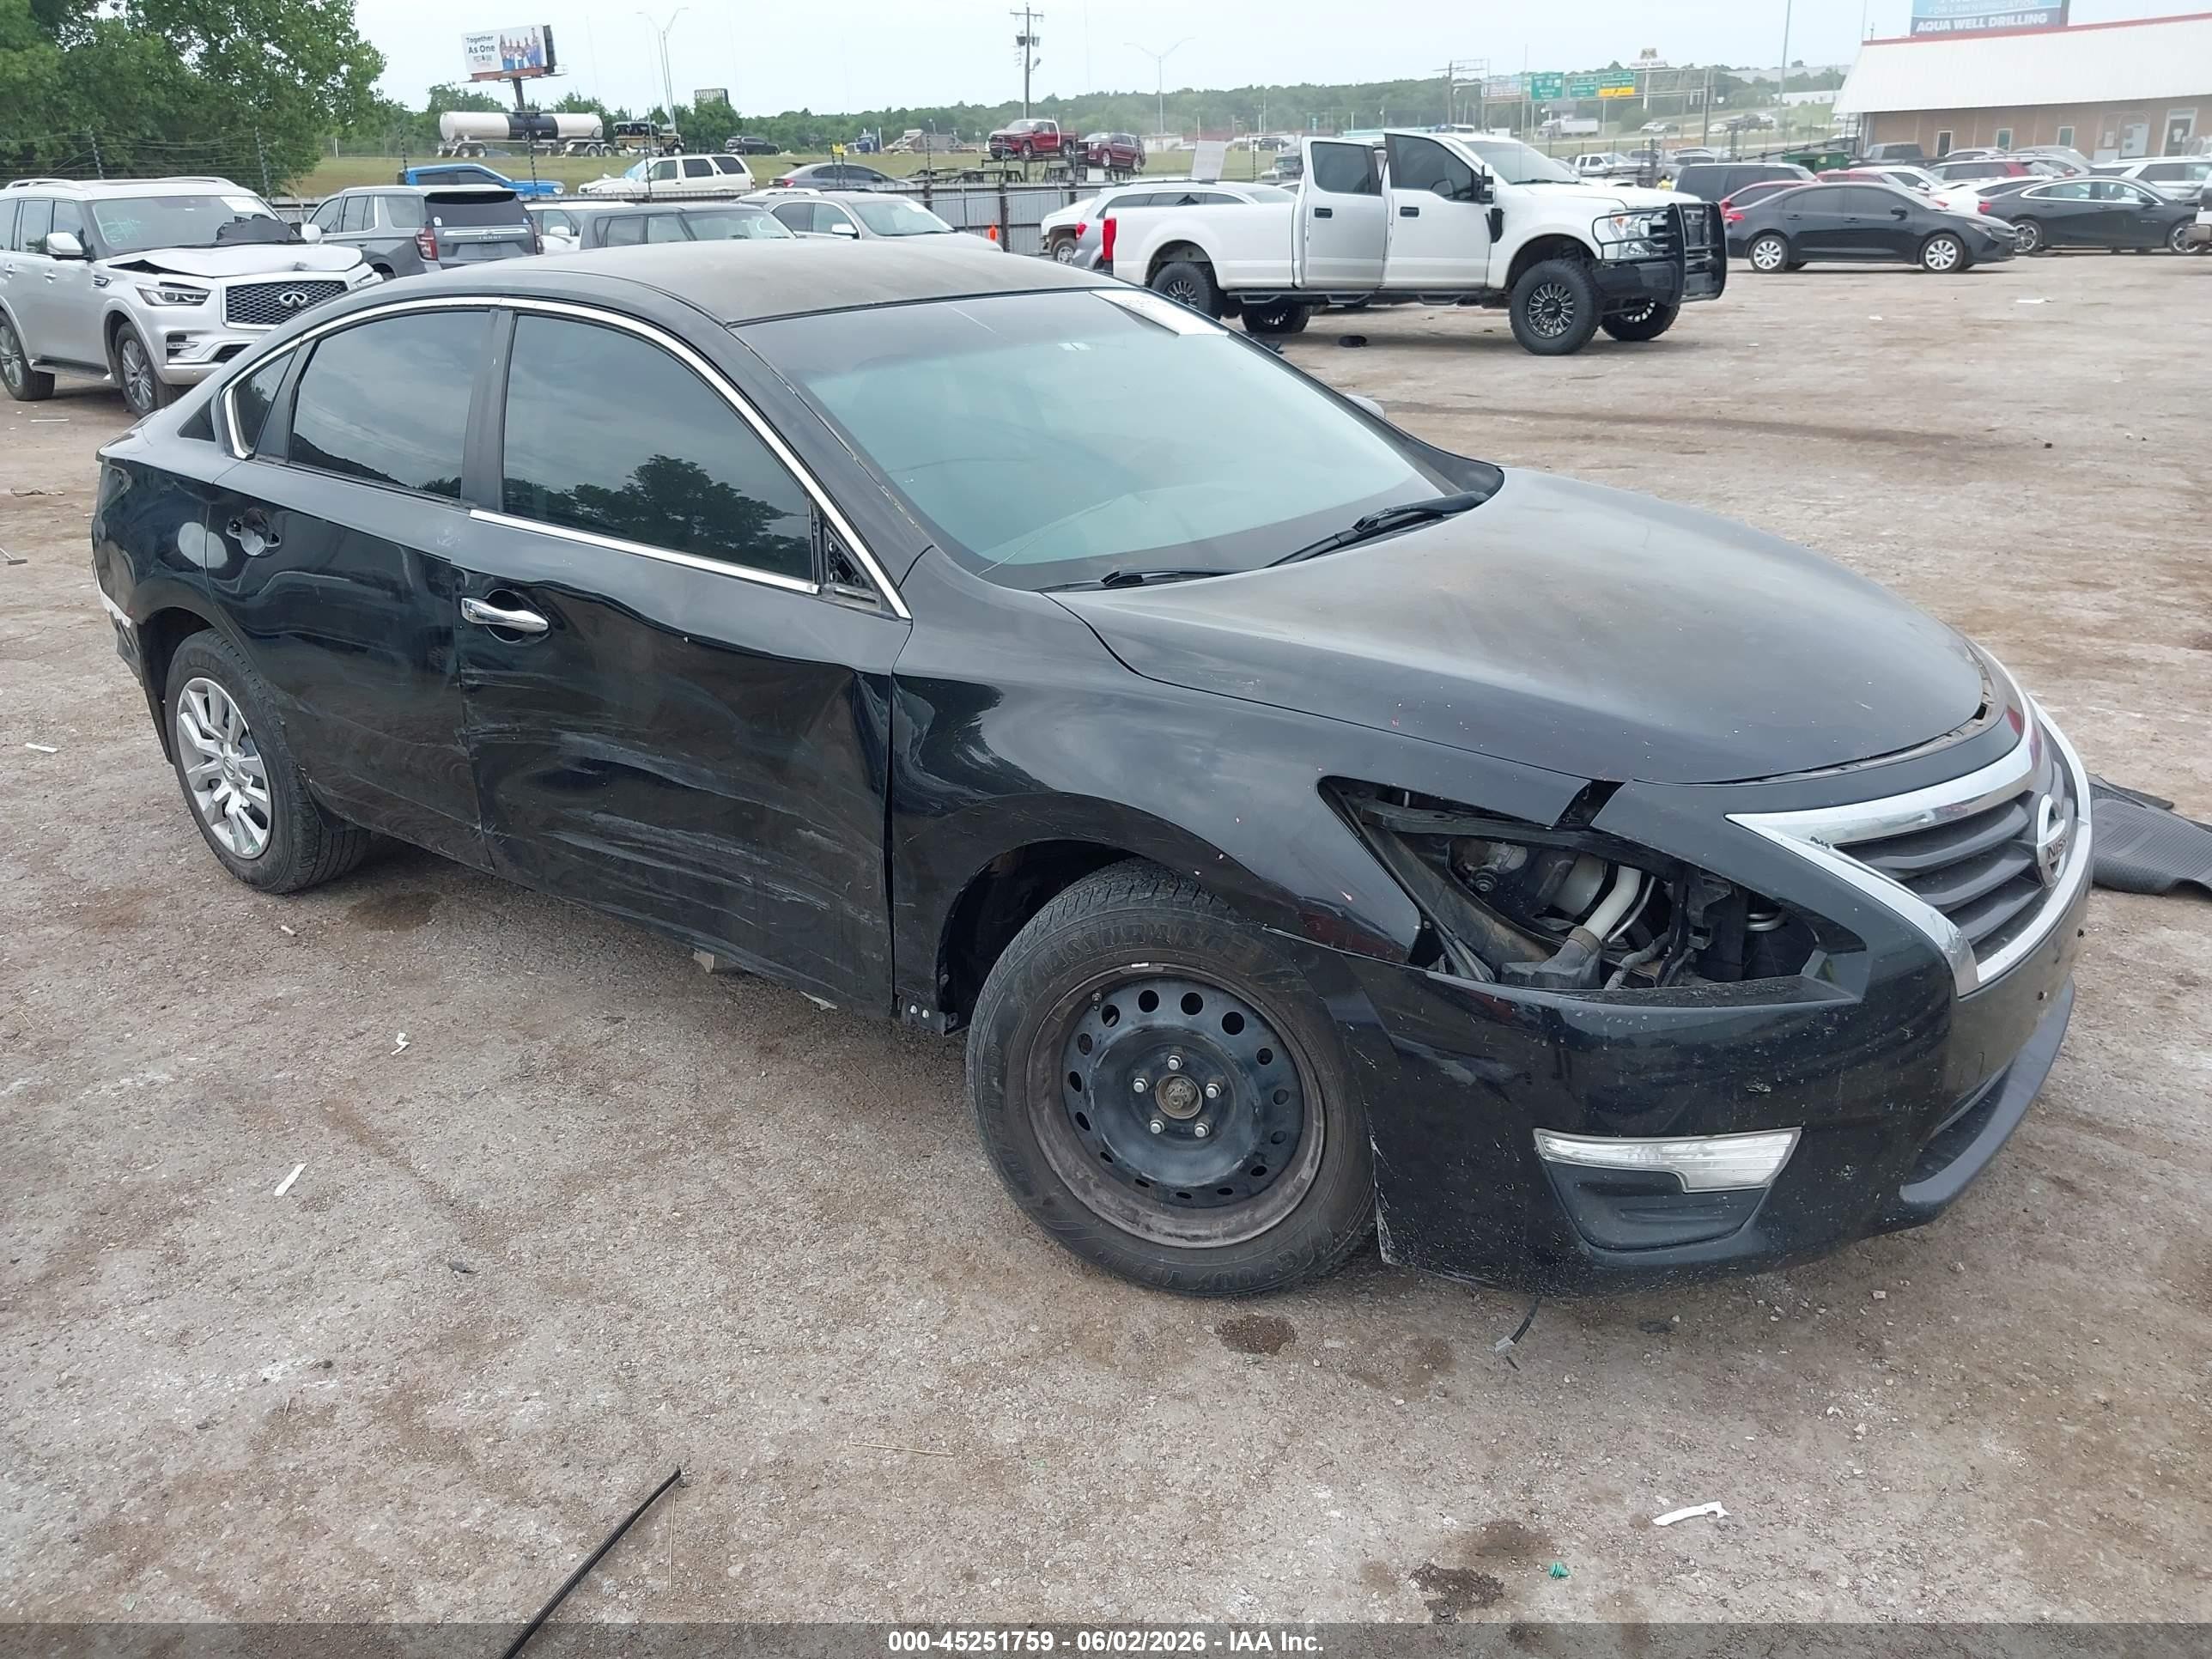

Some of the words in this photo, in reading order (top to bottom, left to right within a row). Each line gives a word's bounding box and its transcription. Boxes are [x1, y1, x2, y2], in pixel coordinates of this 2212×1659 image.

[1916, 20, 1951, 32] AQUA
[1954, 17, 1986, 29] WELL
[1988, 13, 2048, 27] DRILLING
[479, 45, 495, 53] One
